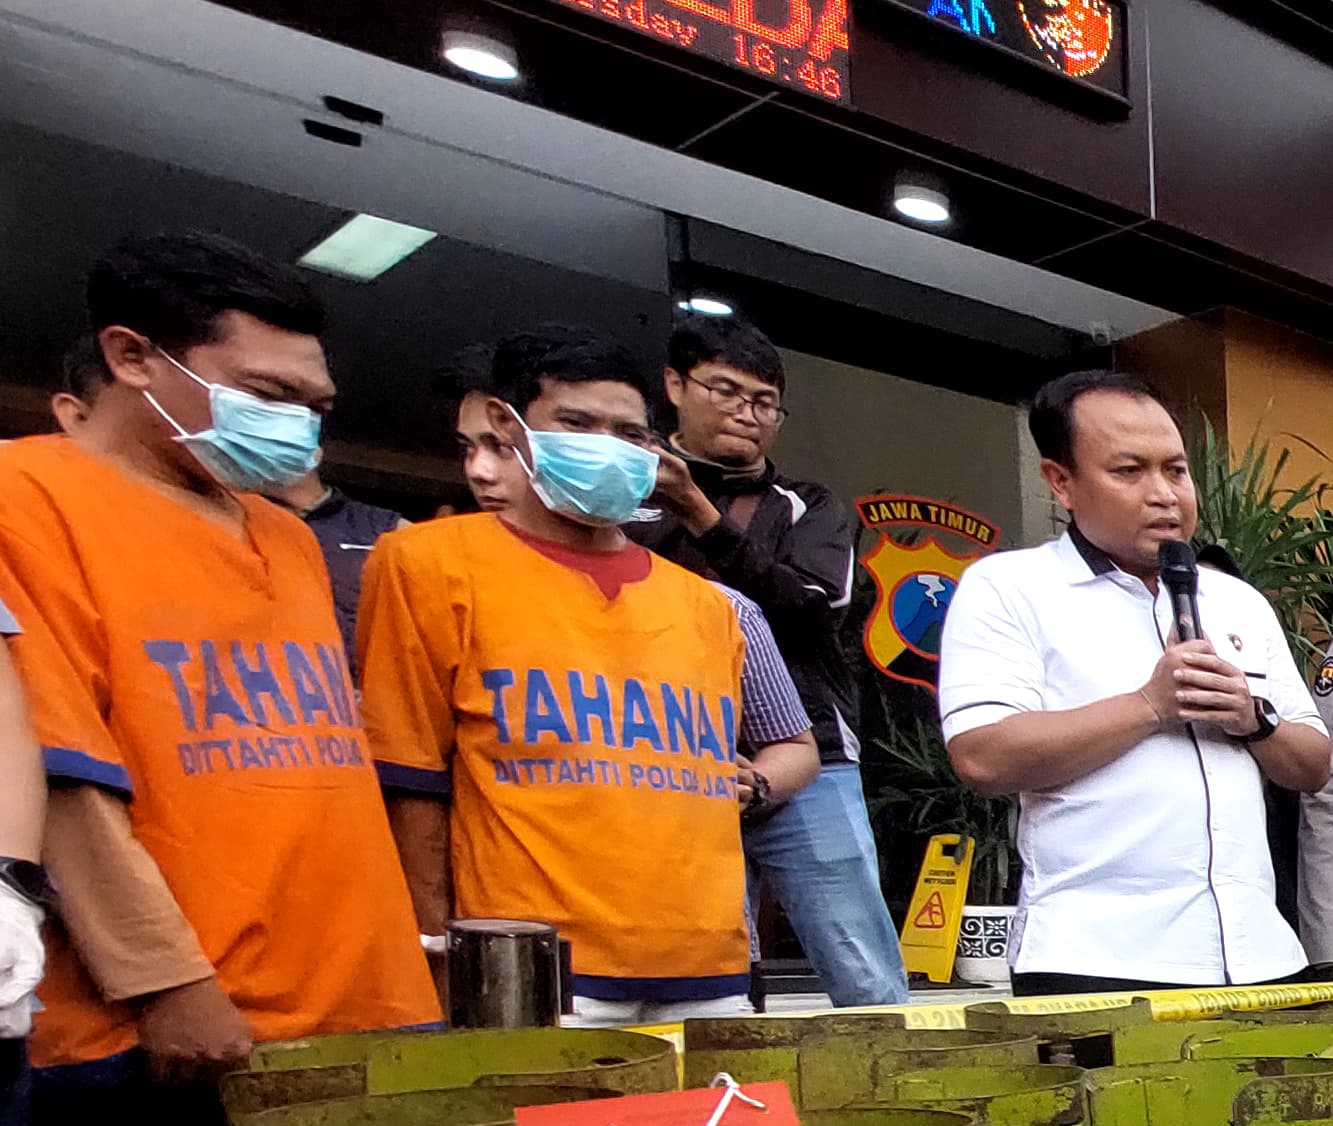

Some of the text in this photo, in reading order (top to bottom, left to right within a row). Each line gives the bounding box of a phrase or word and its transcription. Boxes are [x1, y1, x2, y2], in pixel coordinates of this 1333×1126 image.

[733, 33, 842, 99] 16:46
[869, 502, 991, 542] JAWA TIMUR
[491, 757, 622, 787] DITTAHTI
